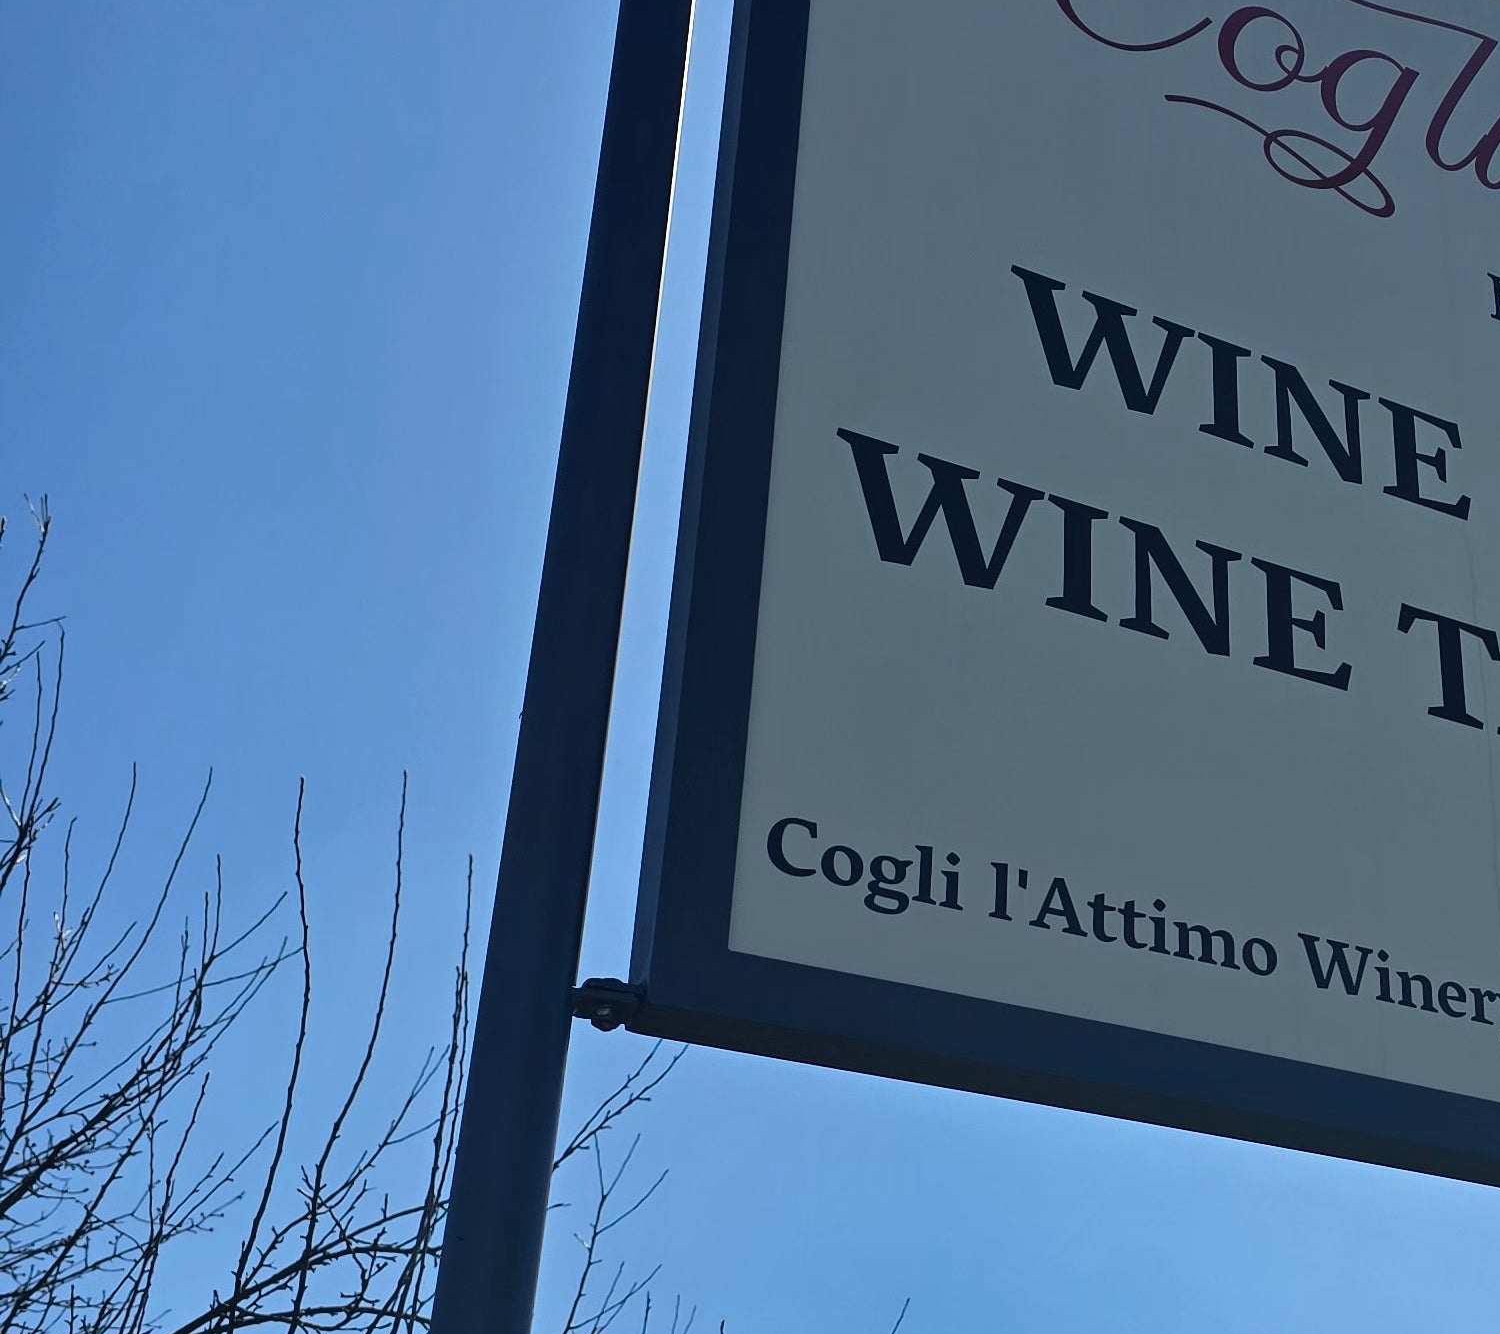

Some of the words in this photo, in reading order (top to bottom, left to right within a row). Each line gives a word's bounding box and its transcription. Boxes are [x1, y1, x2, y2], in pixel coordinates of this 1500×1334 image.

[1010, 264, 1473, 522] WINE
[835, 426, 1353, 692] WINE
[766, 816, 964, 916] Cogli
[988, 860, 1279, 978] l'Attimo
